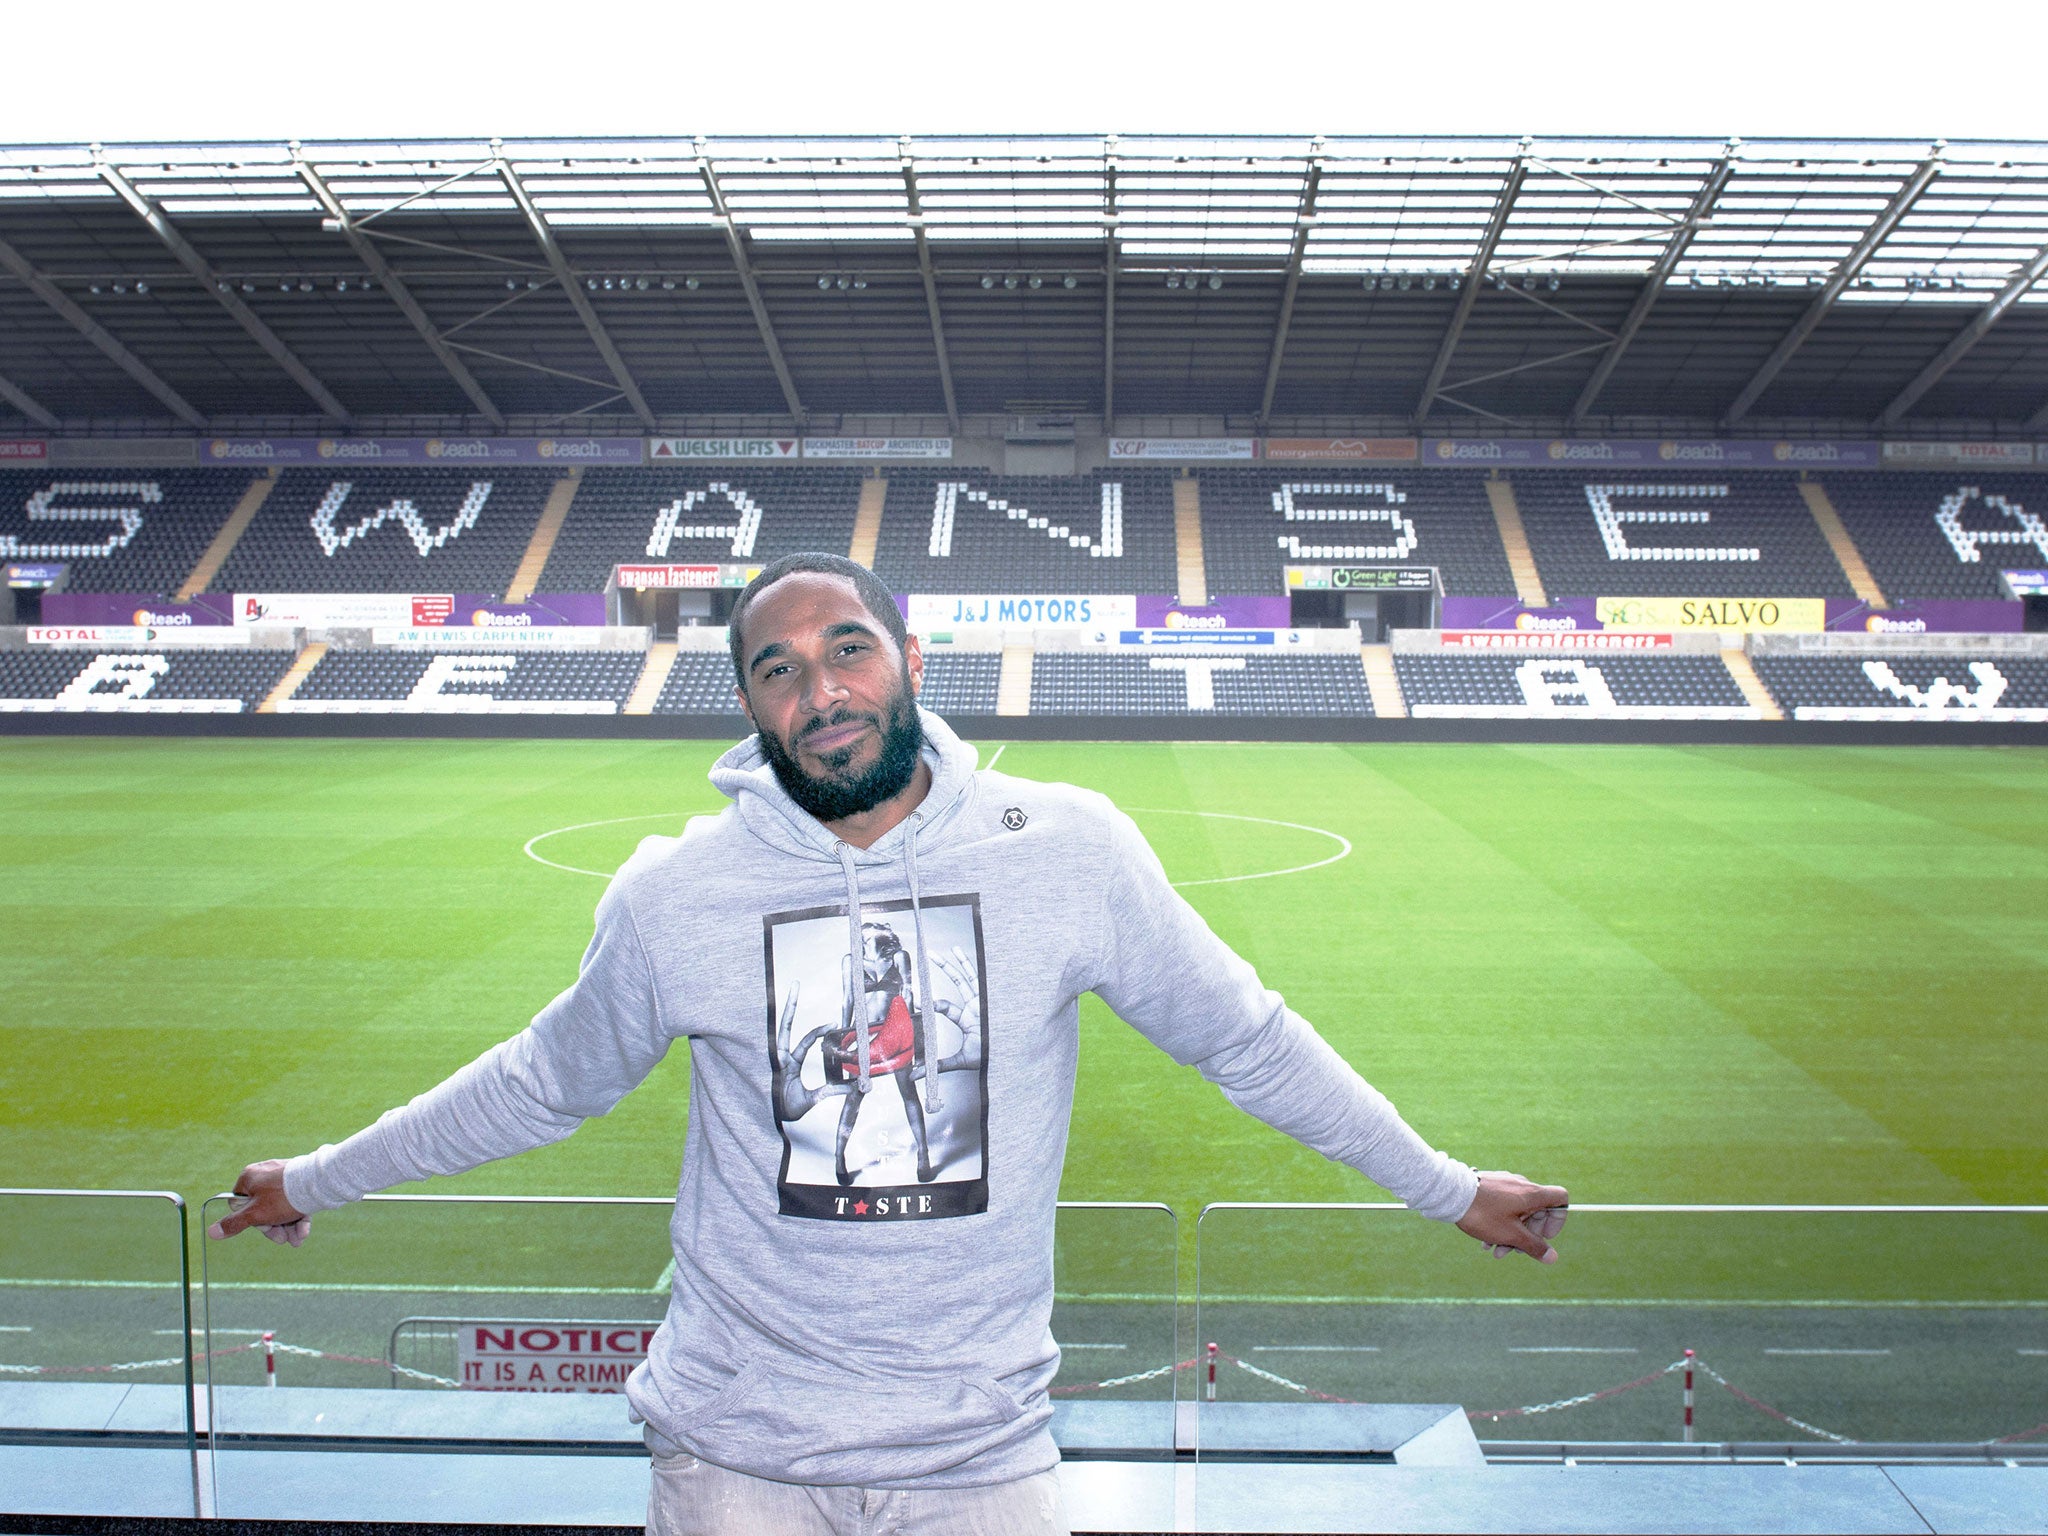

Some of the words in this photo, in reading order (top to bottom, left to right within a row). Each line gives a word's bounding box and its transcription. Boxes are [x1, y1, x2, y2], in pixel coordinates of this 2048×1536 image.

[675, 441, 729, 456] WELSH
[734, 441, 774, 456] LIFTS
[888, 440, 934, 450] ARCHITECTS
[935, 440, 950, 450] LTD
[1113, 441, 1147, 455] SCP
[1960, 446, 2006, 456] TOTAL
[1270, 449, 1362, 459] morganstone
[620, 570, 666, 587] swansea
[668, 566, 719, 587] fasteners
[1352, 569, 1376, 580] Green
[1378, 569, 1397, 582] Light
[139, 610, 193, 627] eteach
[478, 610, 532, 627] eteach
[953, 599, 988, 622] J&J
[999, 599, 1091, 622] MOTORS
[1682, 601, 1779, 625] SALVO
[1171, 611, 1227, 628] eteach
[1521, 613, 1577, 630] eteach
[1871, 615, 1927, 632] eteach
[32, 629, 102, 640] TOTAL
[425, 631, 467, 641] LEWIS
[472, 631, 553, 641] CARPENTRY
[464, 1362, 483, 1381] IT
[495, 1362, 515, 1382] IS
[528, 1363, 547, 1383] A
